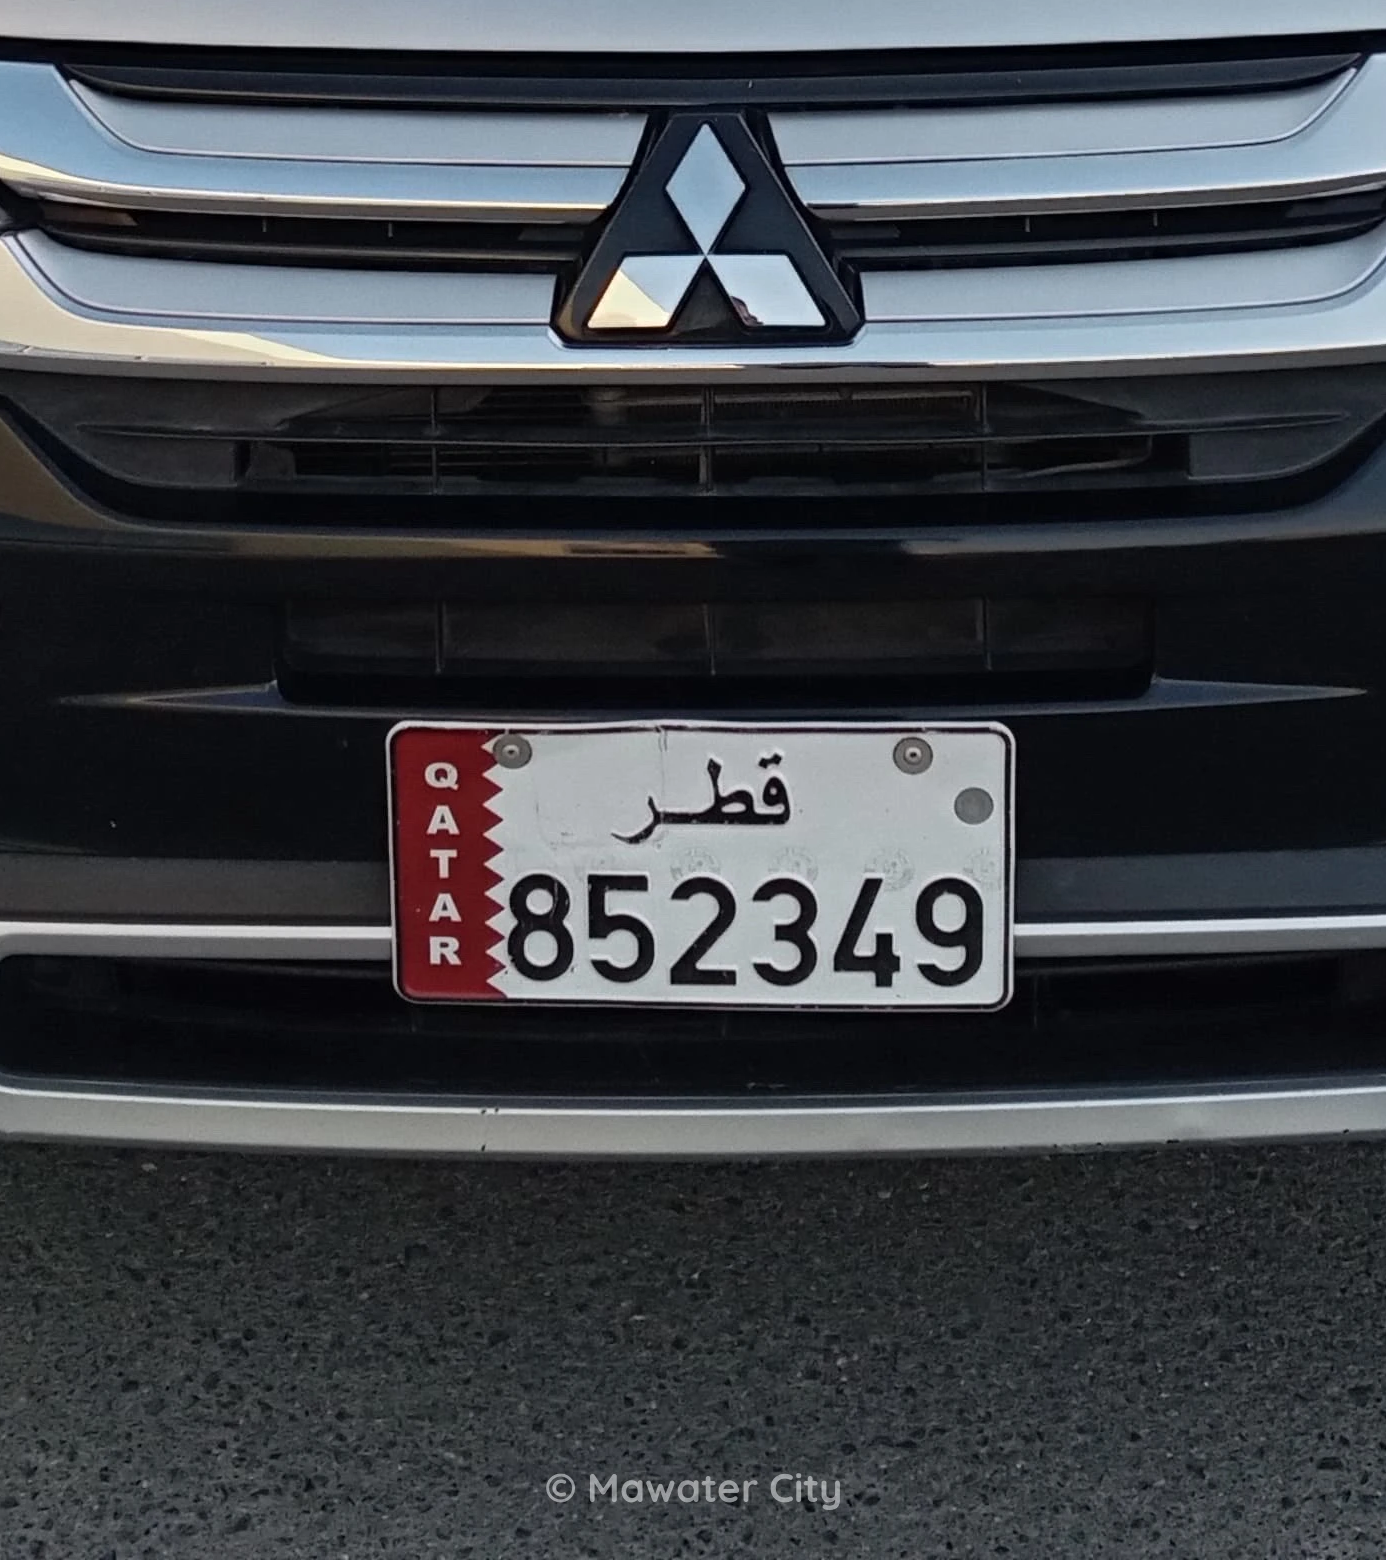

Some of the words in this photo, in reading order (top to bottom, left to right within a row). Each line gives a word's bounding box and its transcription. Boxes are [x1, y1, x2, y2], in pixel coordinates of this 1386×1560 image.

[611, 752, 791, 844] قطر
[423, 762, 463, 966] QATAR
[508, 873, 985, 988] 852349
